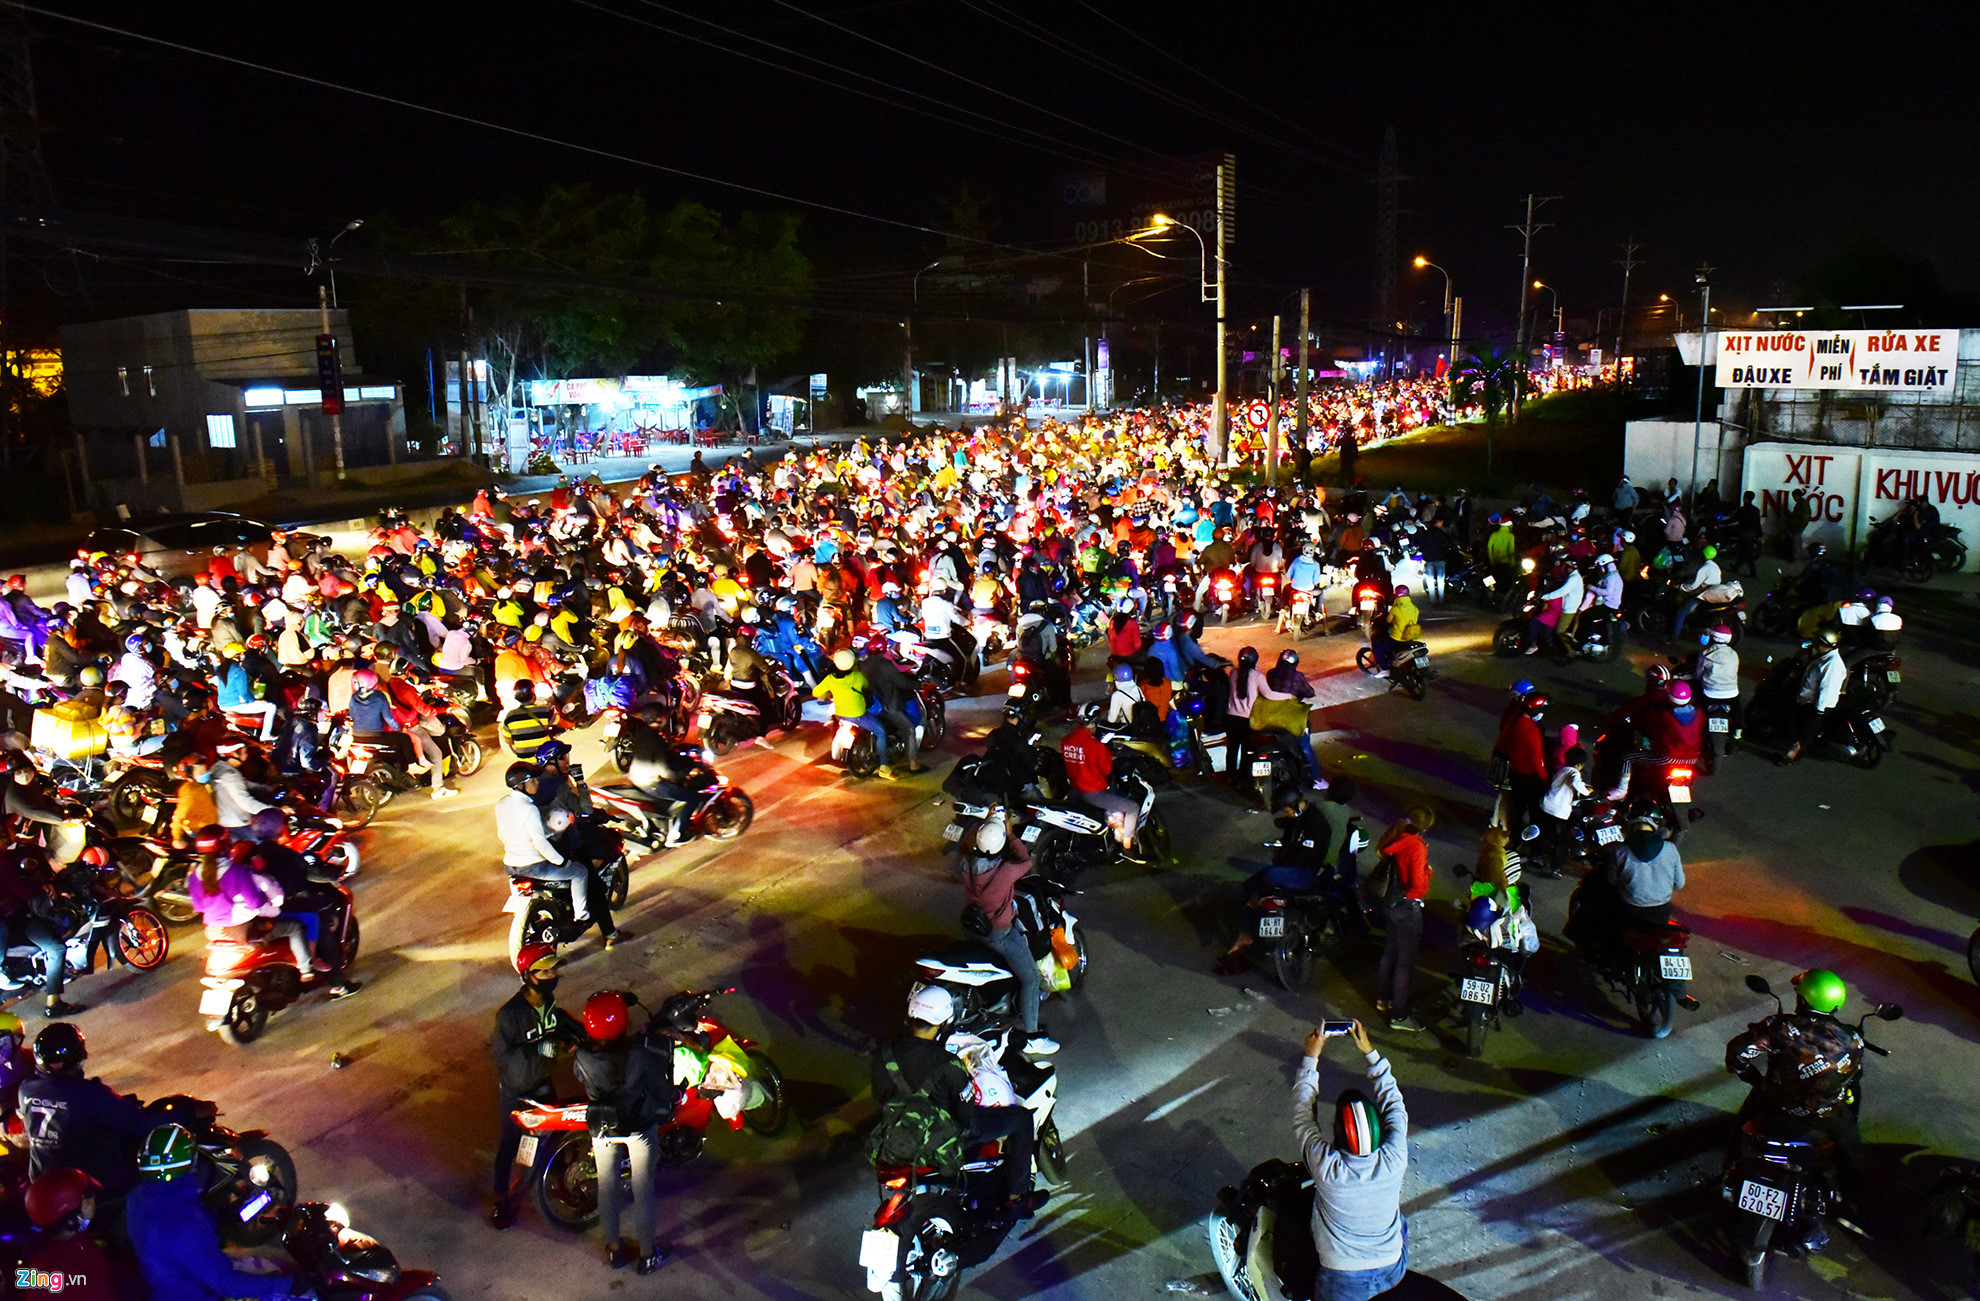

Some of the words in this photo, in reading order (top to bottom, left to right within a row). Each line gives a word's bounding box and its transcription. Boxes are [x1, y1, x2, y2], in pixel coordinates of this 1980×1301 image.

[1725, 336, 1752, 355] XỊT
[1756, 332, 1806, 352] NƯỚC
[1816, 334, 1850, 354] MIỄN
[1867, 330, 1908, 353] RỬA
[1914, 335, 1941, 352] XE
[1820, 363, 1842, 380] PHÍ
[1860, 362, 1900, 386] TẮM
[1904, 362, 1948, 390] GIẶT
[1784, 454, 1834, 489] XỊT
[1875, 468, 1932, 500] KHU
[23, 1096, 68, 1110] VOGUE
[31, 1105, 56, 1138] 7
[1748, 1183, 1779, 1204] 60-F2
